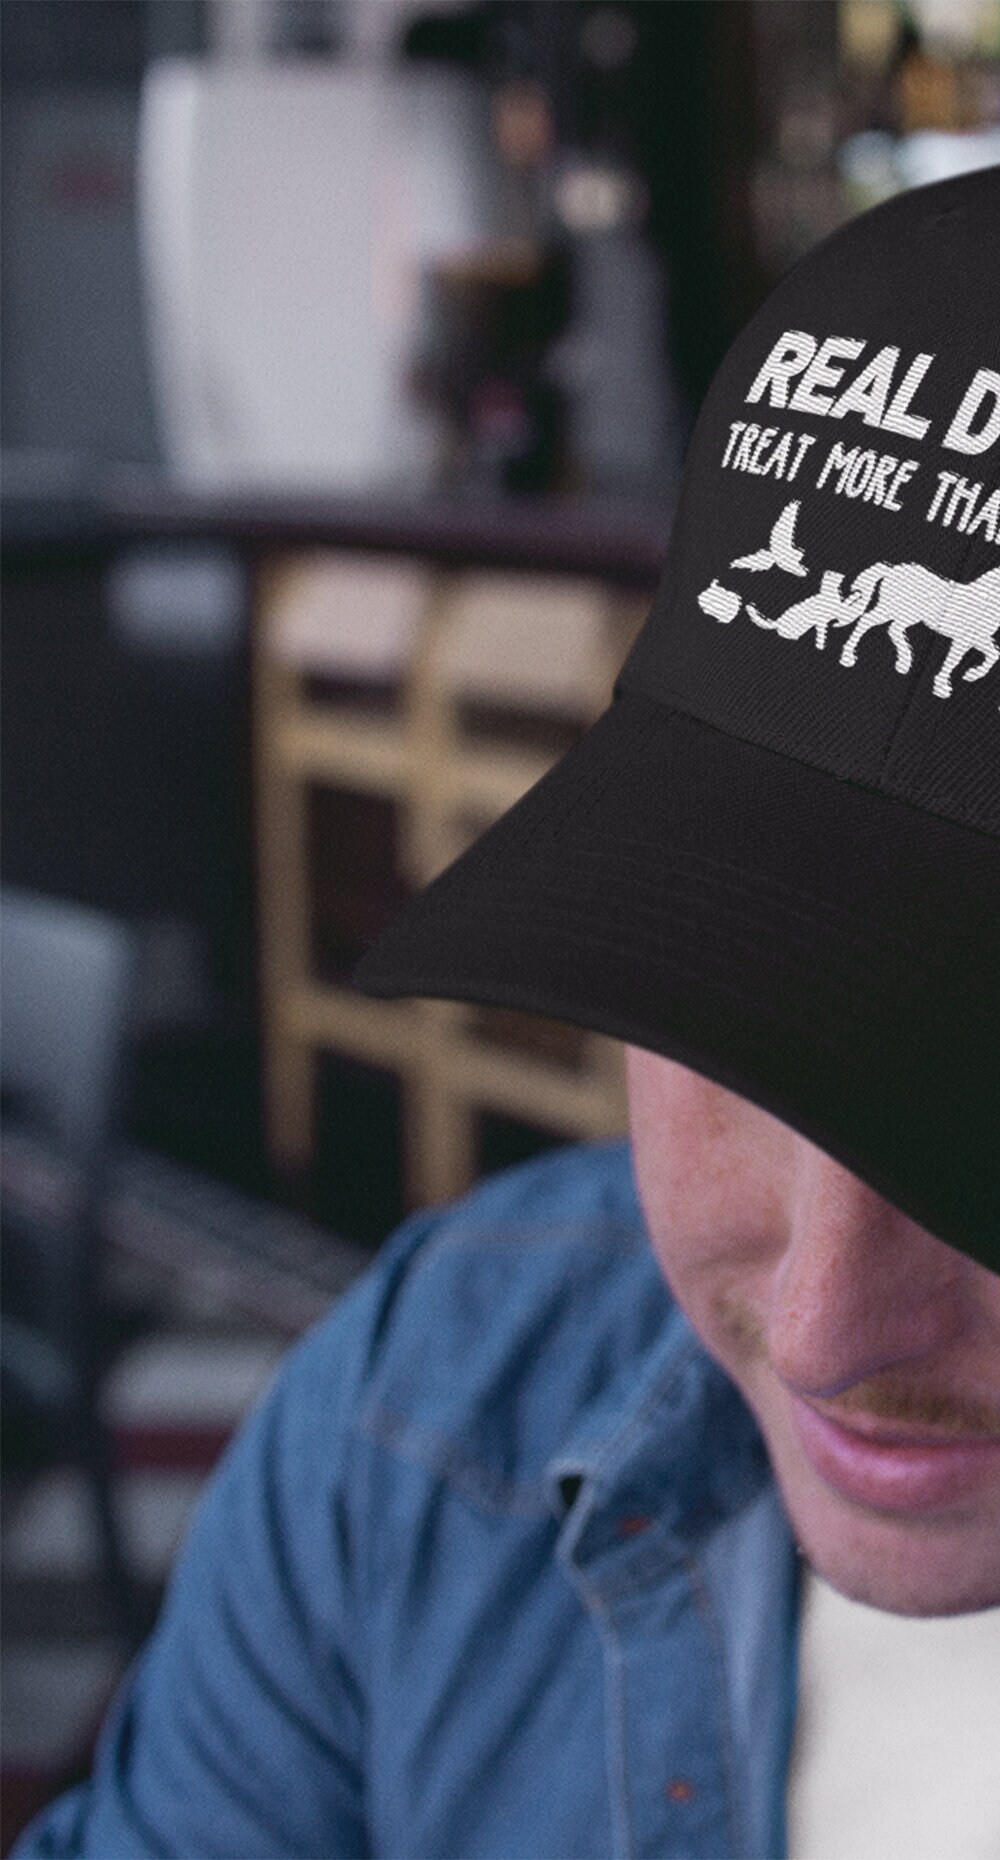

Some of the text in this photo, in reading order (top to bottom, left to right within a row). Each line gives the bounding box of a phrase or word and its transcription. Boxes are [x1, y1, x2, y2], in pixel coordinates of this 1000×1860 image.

[743, 329, 936, 441] REAL
[721, 420, 817, 482] TREAT
[815, 441, 920, 512] MORE
